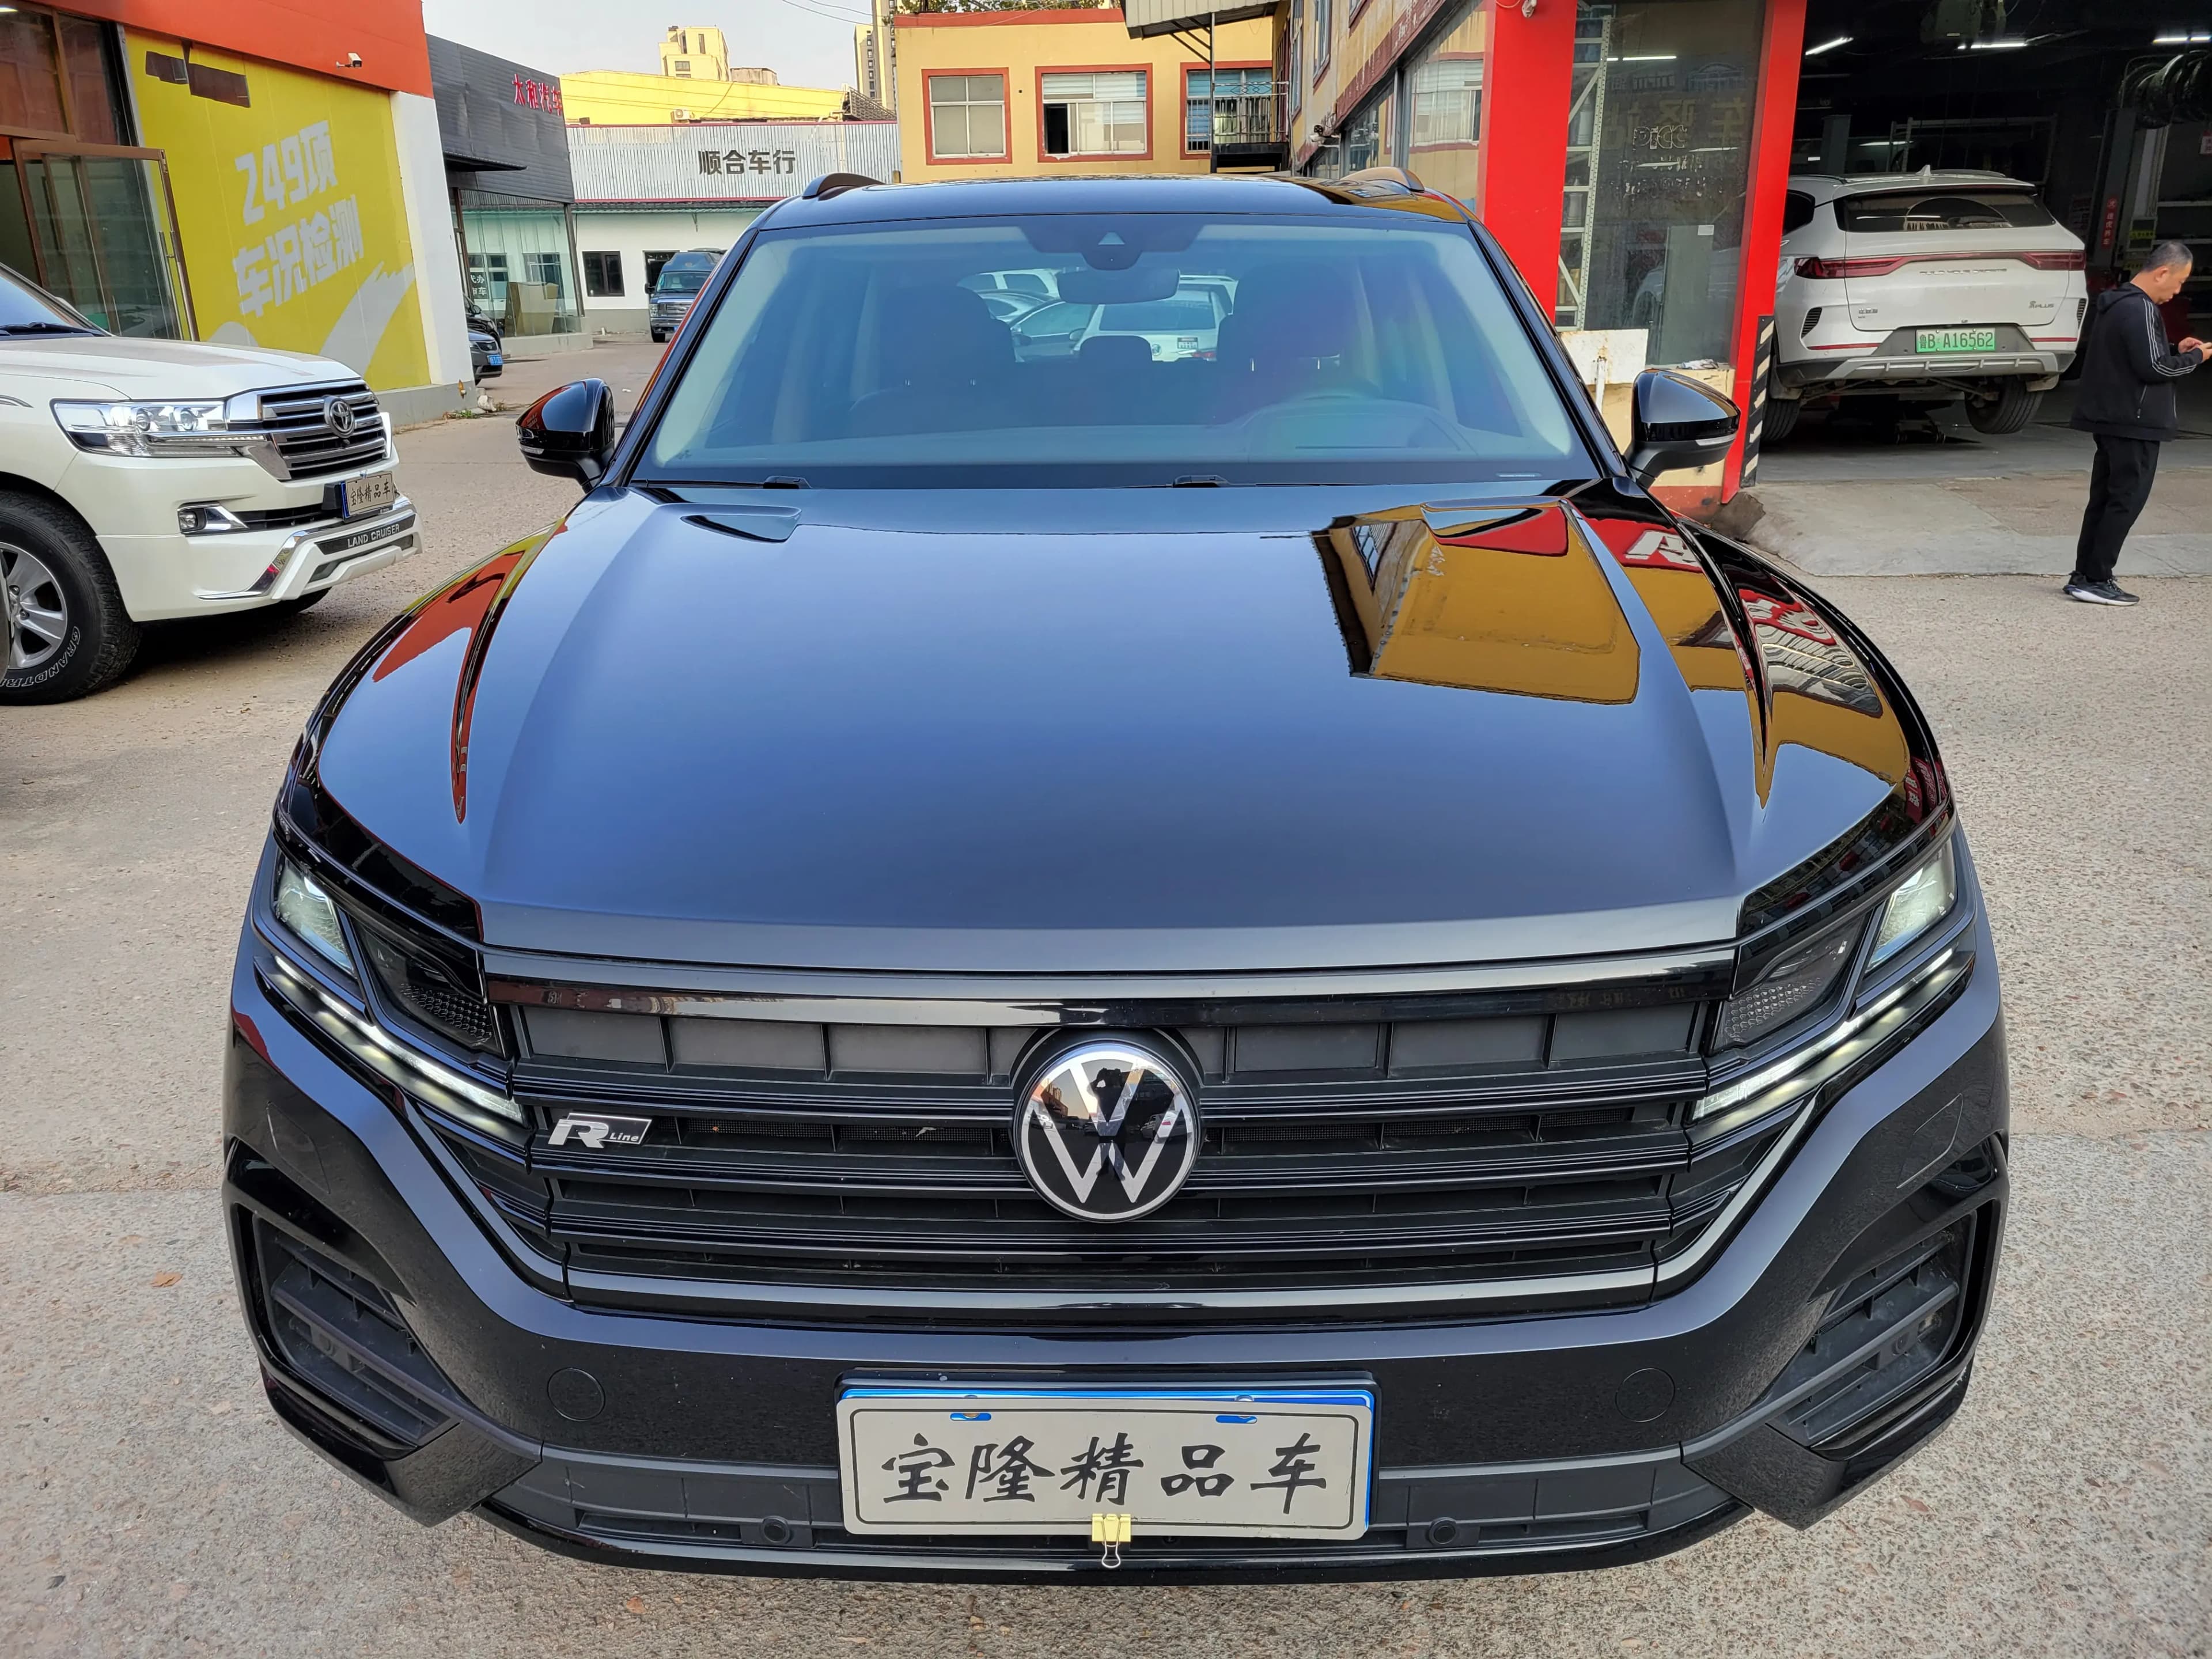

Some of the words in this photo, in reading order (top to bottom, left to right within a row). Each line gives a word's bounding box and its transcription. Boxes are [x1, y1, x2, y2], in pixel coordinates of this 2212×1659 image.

[234, 119, 338, 226] 249项
[698, 149, 796, 175] 顺合车行
[232, 194, 364, 317] 车况检测
[350, 479, 391, 506] 宝隆精品车
[347, 534, 369, 548] LAND
[370, 524, 400, 540] CRUISER
[609, 1132, 639, 1142] Line
[881, 1432, 1328, 1515] 宝隆精品车
